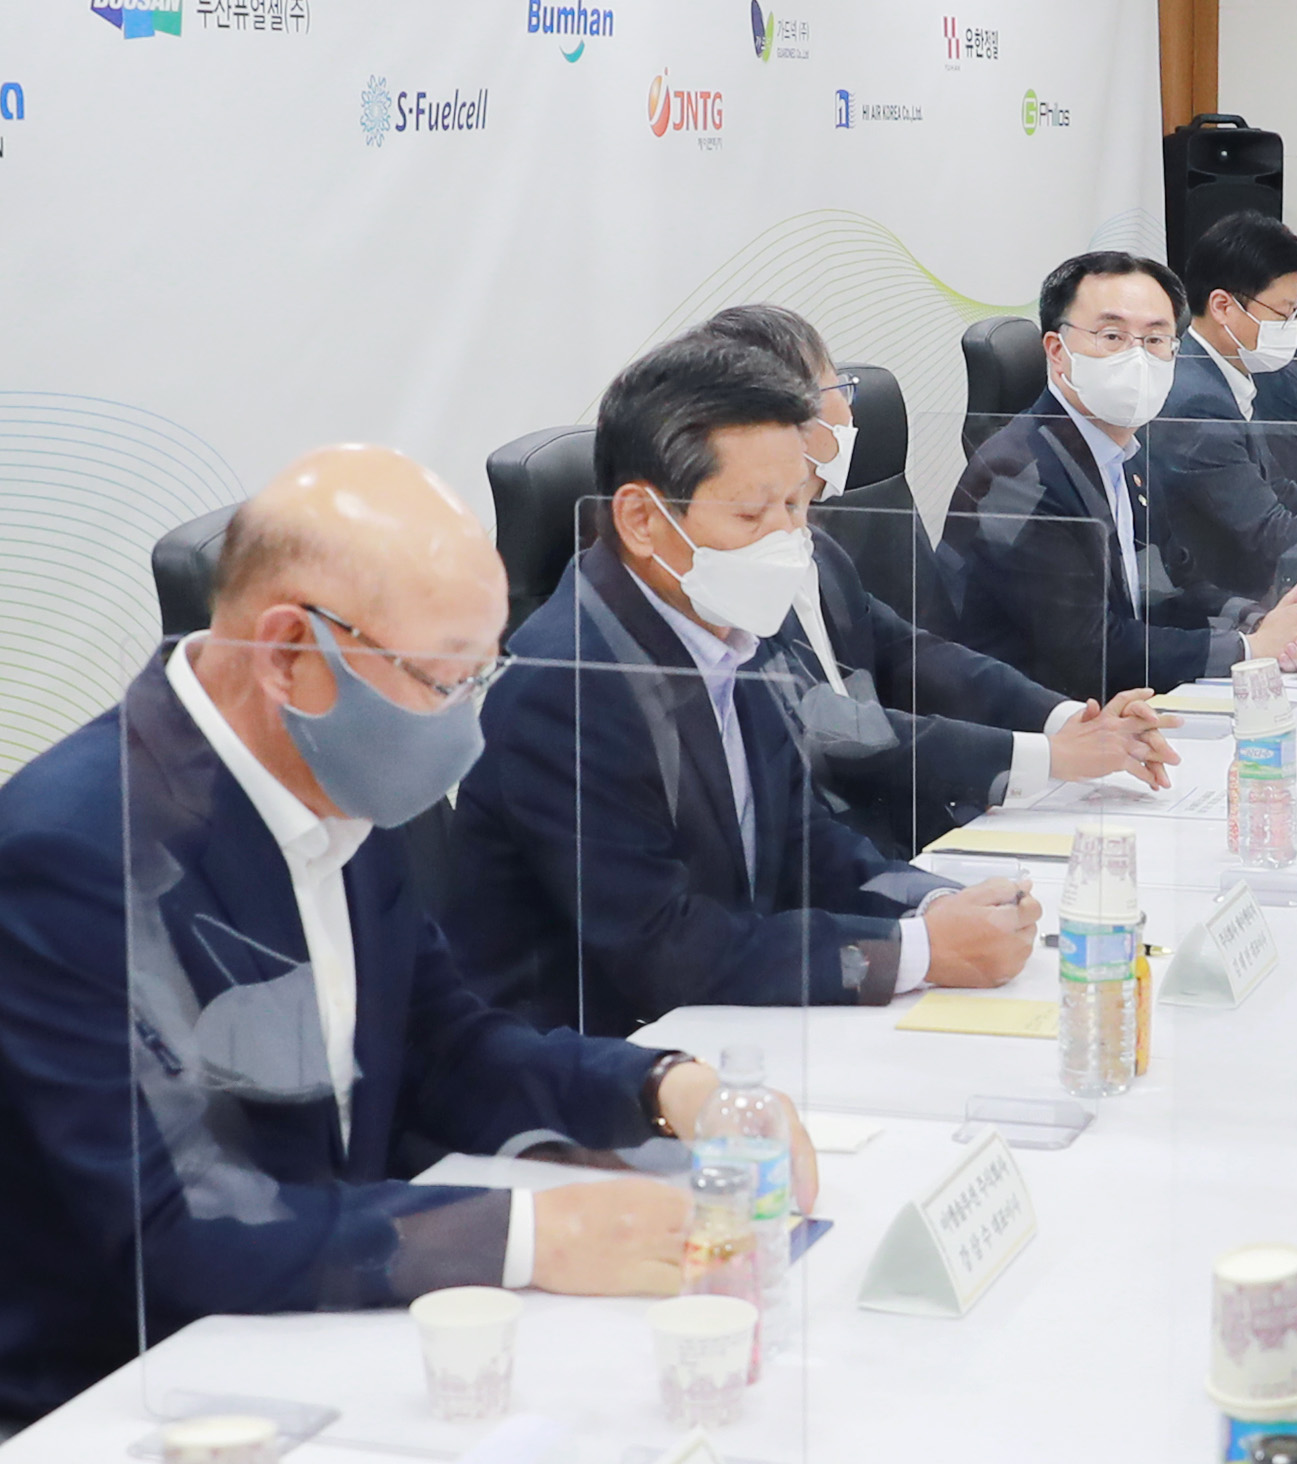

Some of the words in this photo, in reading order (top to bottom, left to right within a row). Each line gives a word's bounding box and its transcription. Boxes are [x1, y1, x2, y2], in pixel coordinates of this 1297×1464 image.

[528, 0, 613, 36] Bumhan
[965, 27, 999, 60] 유한정밀
[673, 90, 723, 131] JNTG
